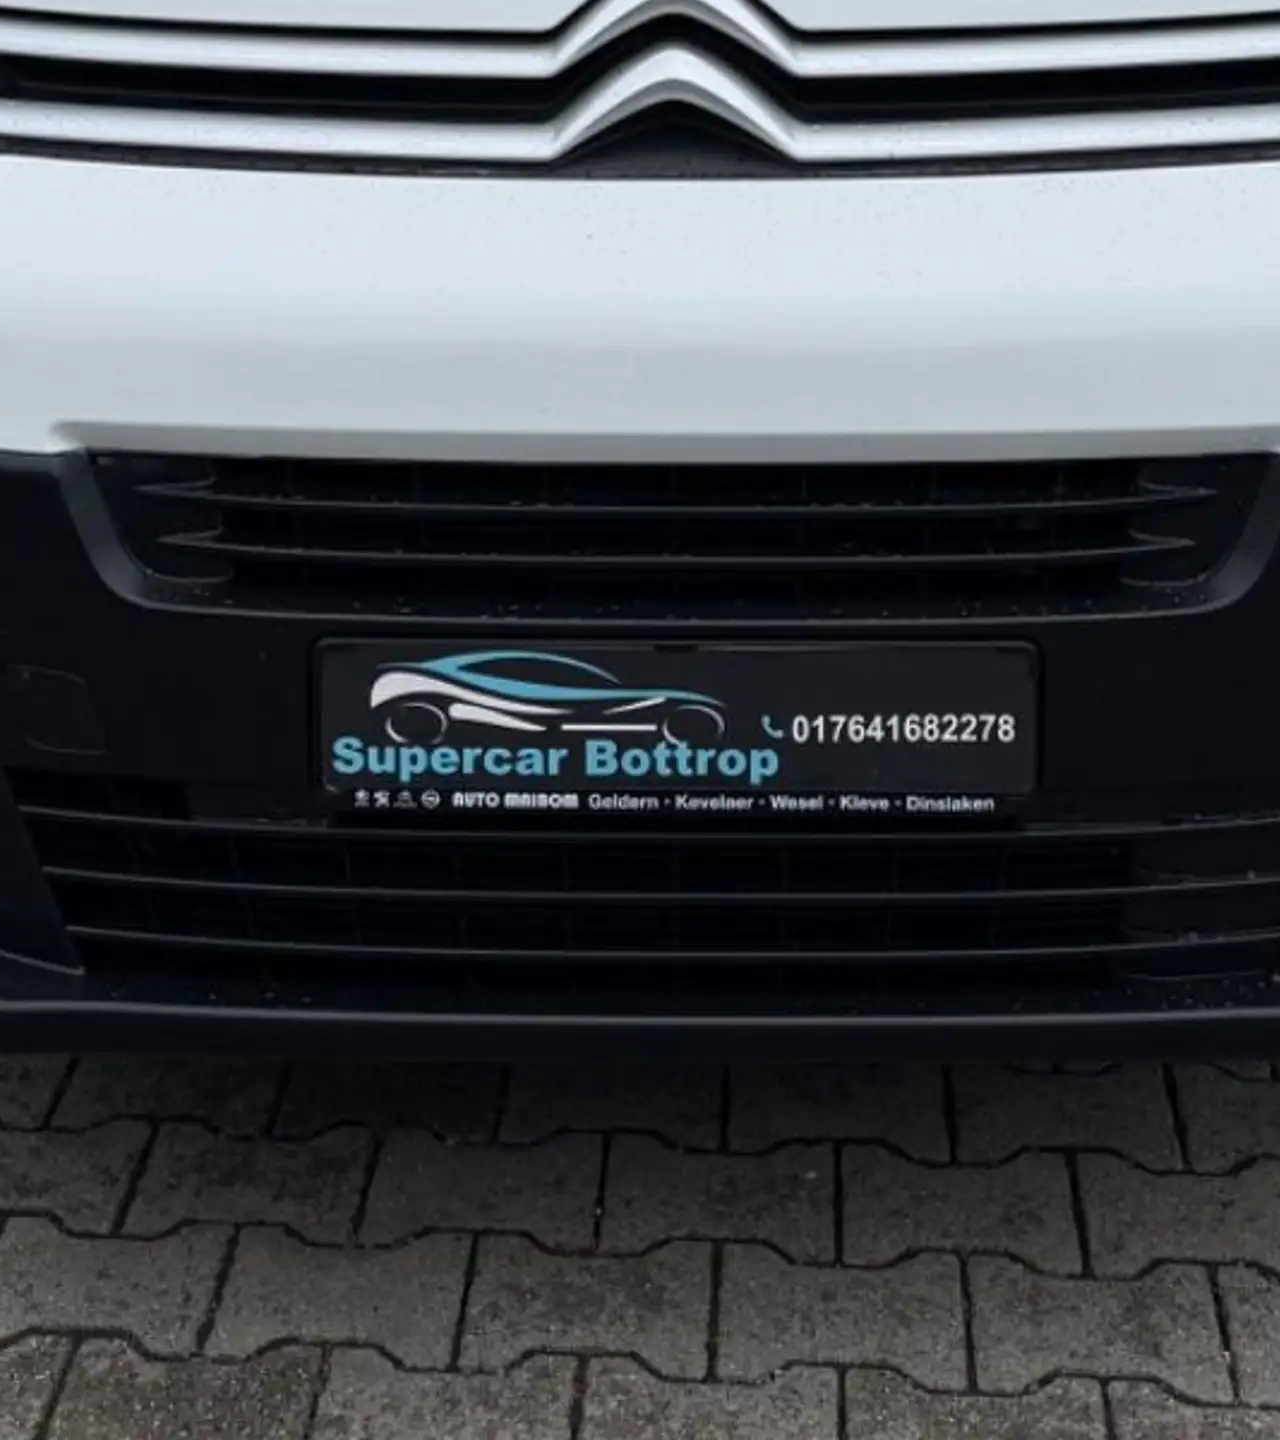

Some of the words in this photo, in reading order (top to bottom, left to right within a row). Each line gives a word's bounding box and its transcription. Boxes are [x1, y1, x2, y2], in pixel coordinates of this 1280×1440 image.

[792, 713, 1016, 743] 017641682278
[332, 737, 568, 781] Supercar
[586, 739, 779, 784] Bottrop
[588, 792, 659, 809] Geldern
[770, 794, 824, 810] Wesel
[839, 795, 888, 811] Kleve
[906, 795, 995, 812] Dinslaken
